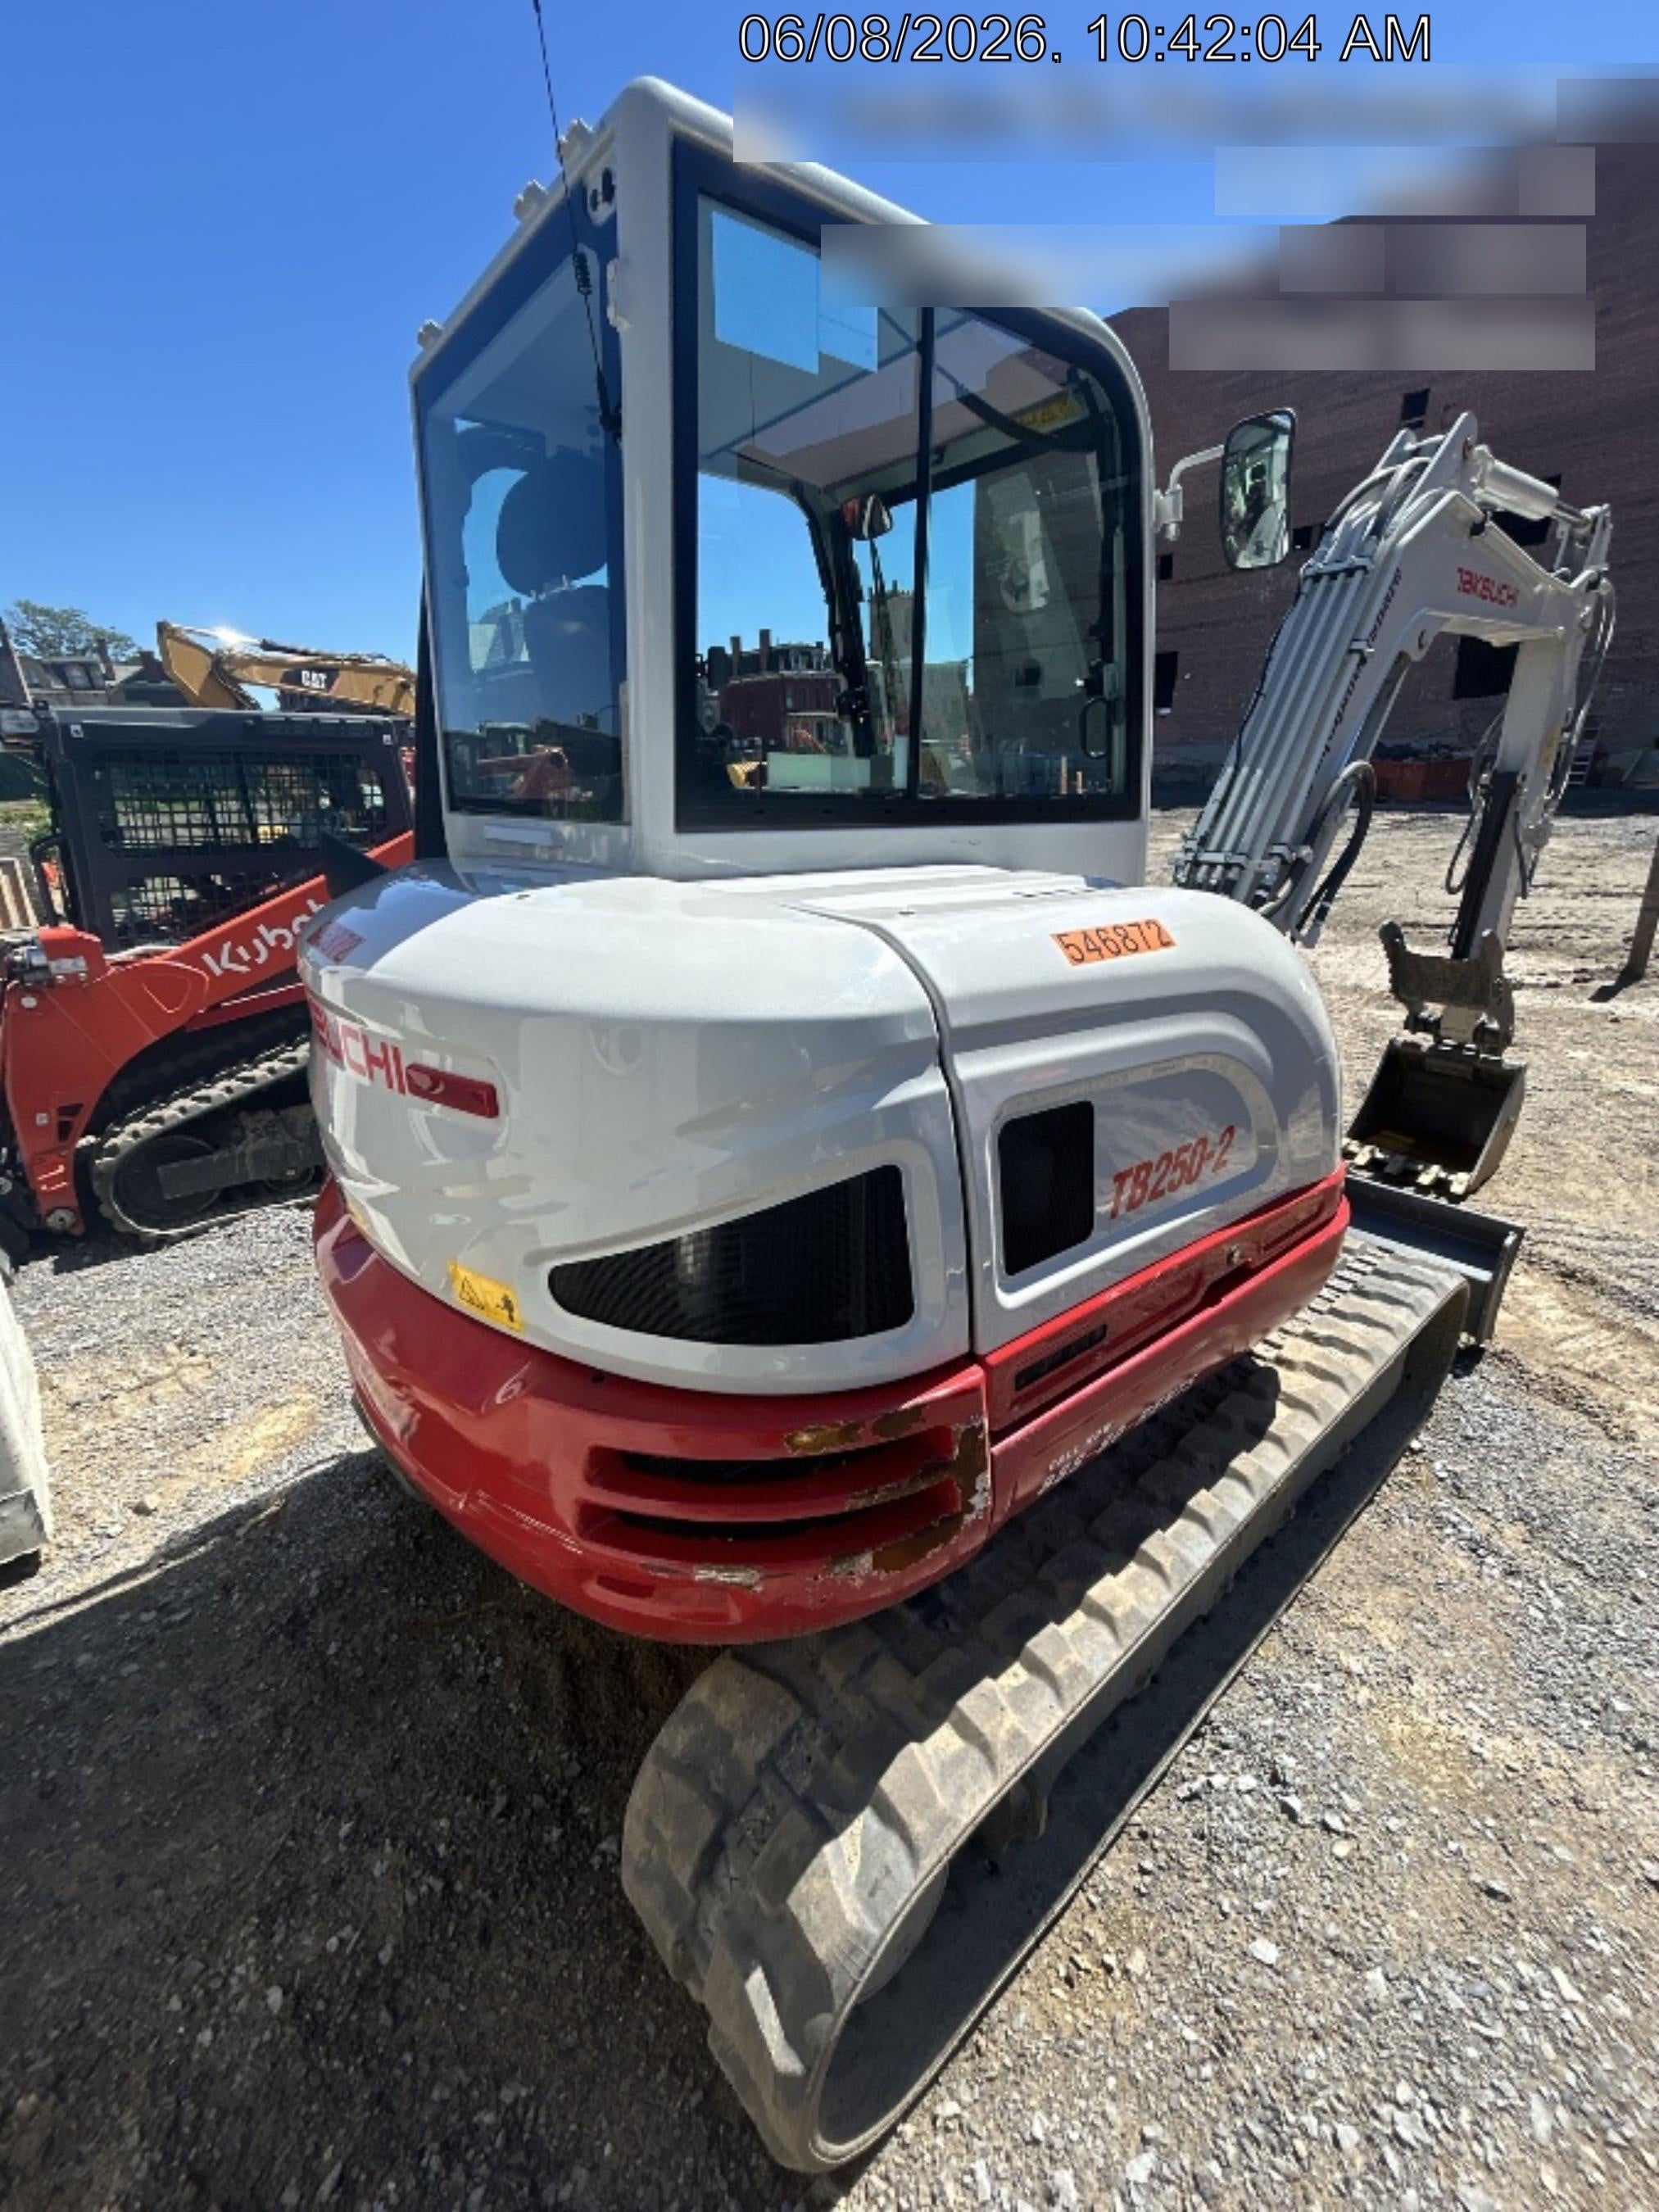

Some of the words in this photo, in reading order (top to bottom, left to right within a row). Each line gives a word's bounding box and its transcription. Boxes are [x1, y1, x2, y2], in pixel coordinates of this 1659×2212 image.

[1456, 567, 1520, 609] TAKEUCHI
[301, 670, 327, 689] CAT
[201, 899, 325, 977] Kubot
[1056, 918, 1172, 963] 546872
[1109, 1124, 1235, 1220] TB250-2
